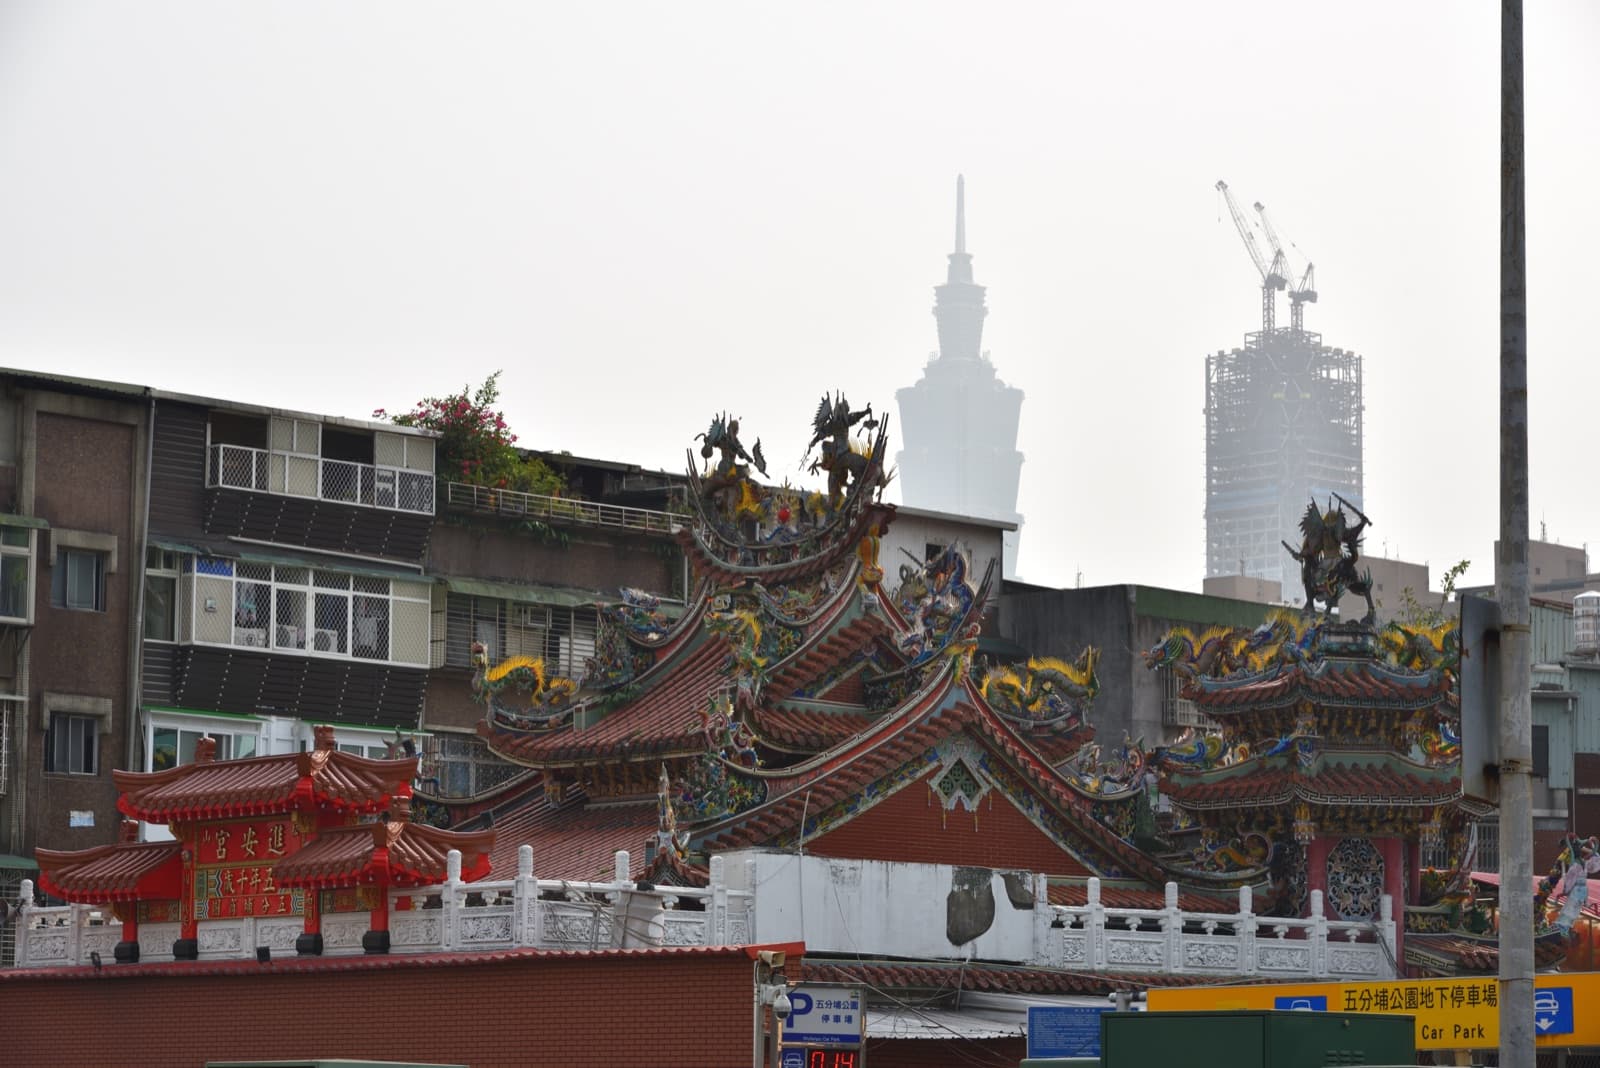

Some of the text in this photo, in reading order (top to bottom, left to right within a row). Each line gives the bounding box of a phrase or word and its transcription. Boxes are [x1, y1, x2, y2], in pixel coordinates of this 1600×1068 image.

[816, 1000, 858, 1010] 五分埔公園
[1343, 983, 1498, 1012] 五分埔公園地下停車場
[786, 993, 813, 1028] P
[821, 1014, 853, 1024] 停車場
[1421, 1023, 1486, 1041] Car Park
